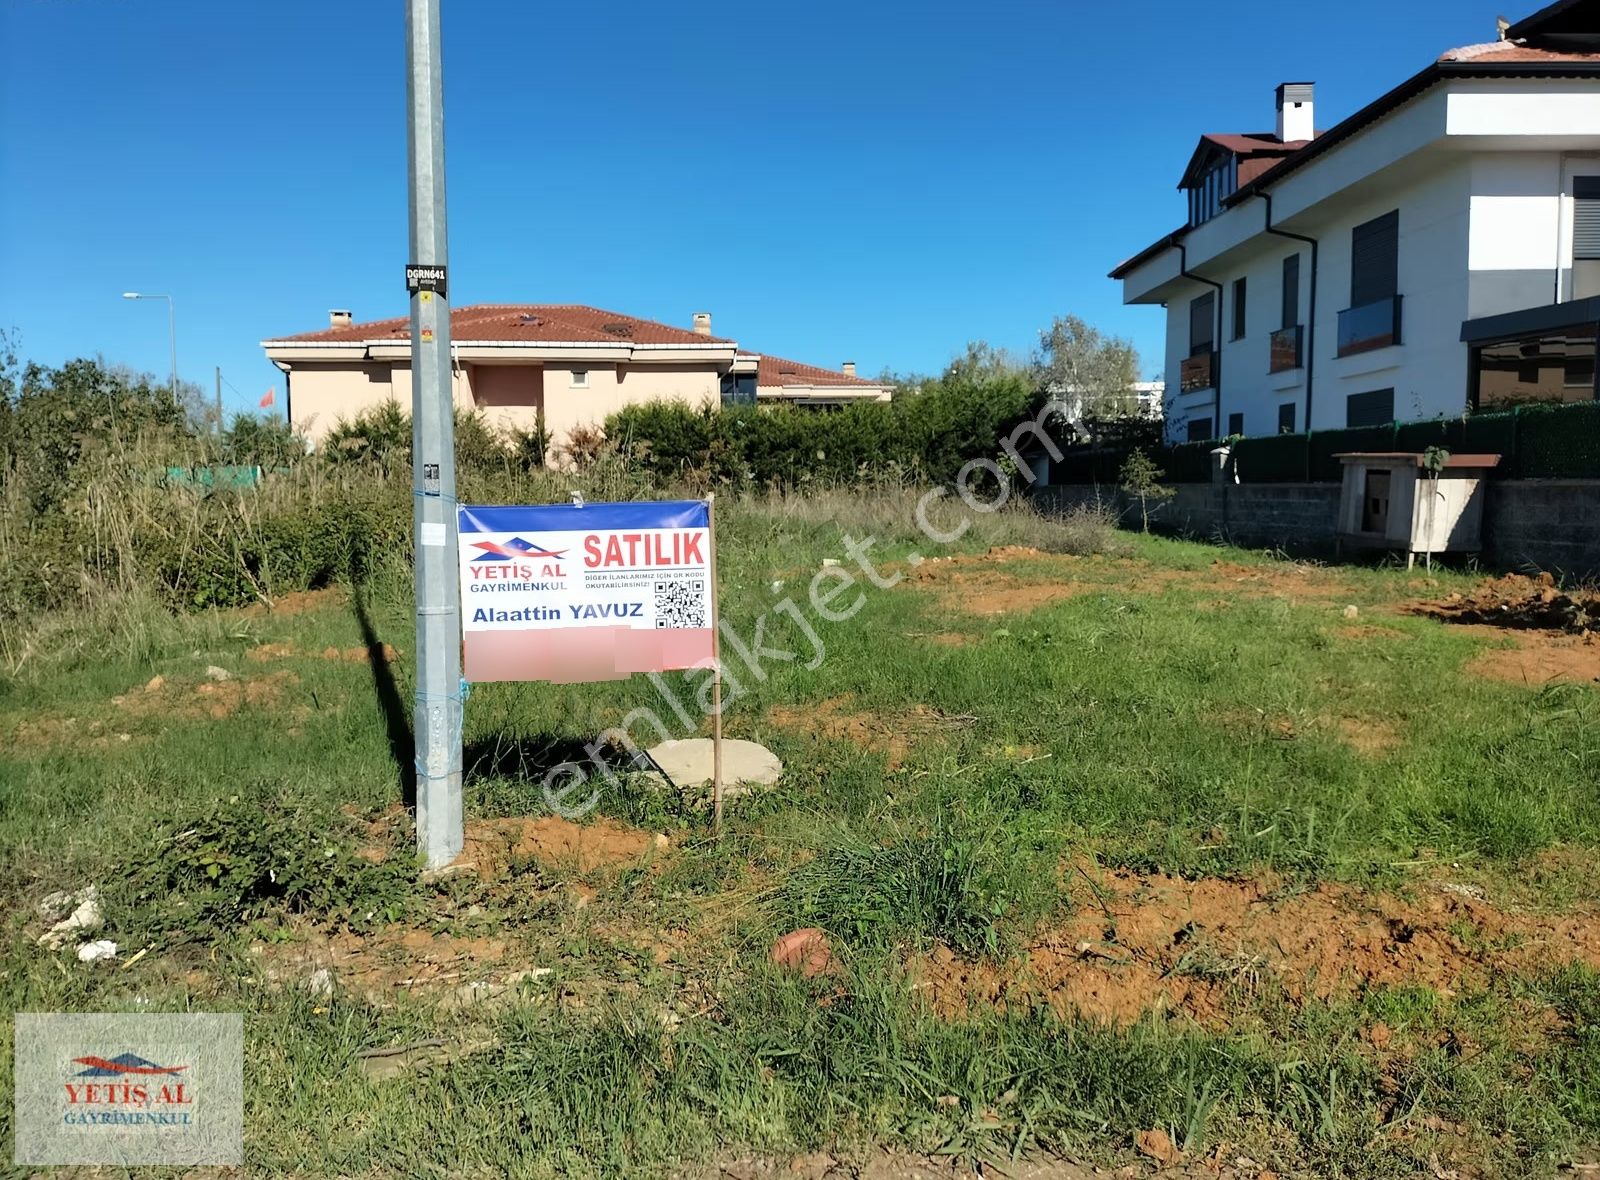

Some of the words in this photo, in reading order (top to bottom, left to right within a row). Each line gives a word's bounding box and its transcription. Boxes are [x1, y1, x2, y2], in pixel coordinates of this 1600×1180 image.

[407, 269, 445, 279] DGRN641
[583, 532, 705, 568] SATILIK
[469, 562, 533, 581] YETİŞ
[540, 564, 567, 578] AL
[609, 573, 655, 581] İLANLARIMIZ
[656, 572, 672, 580] İÇİN
[470, 581, 568, 593] GAYRİMENKUL
[472, 605, 561, 623] Alaattin
[568, 603, 644, 620] YAVUZ
